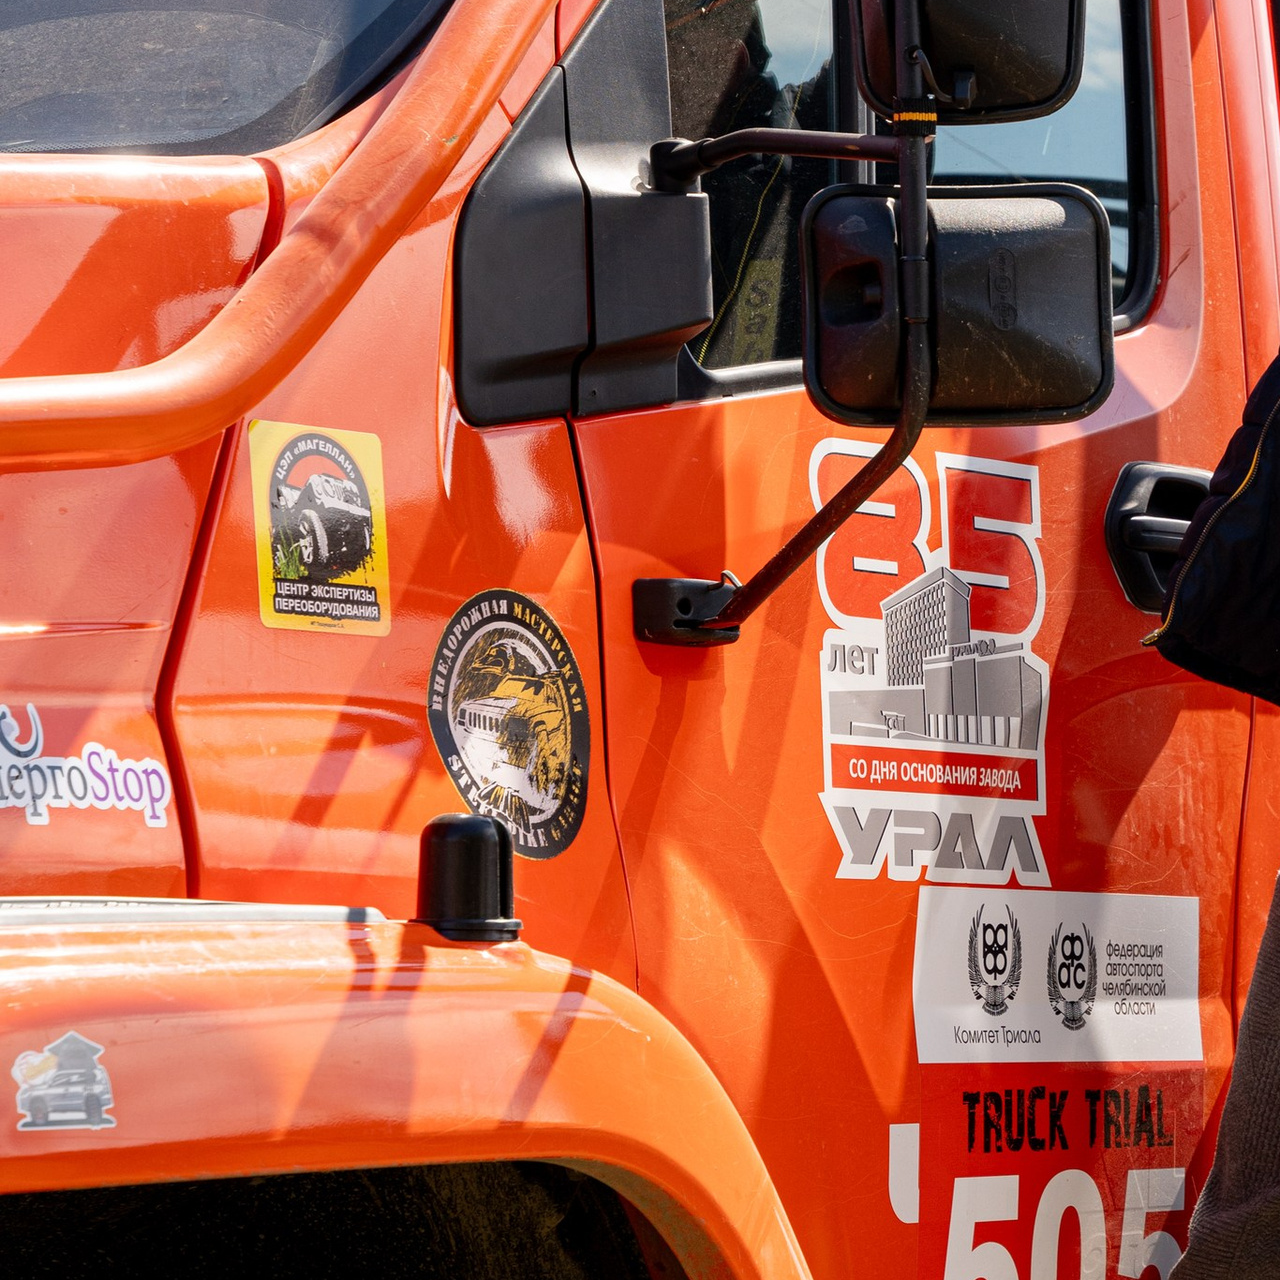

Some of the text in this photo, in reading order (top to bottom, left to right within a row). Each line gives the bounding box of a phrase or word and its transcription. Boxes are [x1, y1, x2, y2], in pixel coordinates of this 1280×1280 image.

[276, 450, 294, 480] ЦЭП
[808, 437, 1047, 639] 85
[276, 581, 376, 603] ЦЕНТР ЭКСПЕРТИЗЫ
[274, 597, 380, 618] ПЕРЕОБОРУДОВАНИЯ
[431, 599, 584, 713] ВНЕДОРОЖНАЯ МАСТЕРСКАЯ
[849, 758, 1022, 793] СО ДНЯ ОСНОВАНИЯ ЗАВОДА
[832, 806, 1040, 873] УРАЛ
[1105, 939, 1164, 962] федерация
[1105, 962, 1164, 980] автоспорта
[1102, 978, 1167, 997] челябинской
[1114, 999, 1157, 1016] области
[954, 1025, 1042, 1048] Комитет Триала
[962, 1083, 1174, 1153] TRUCK TRIAL
